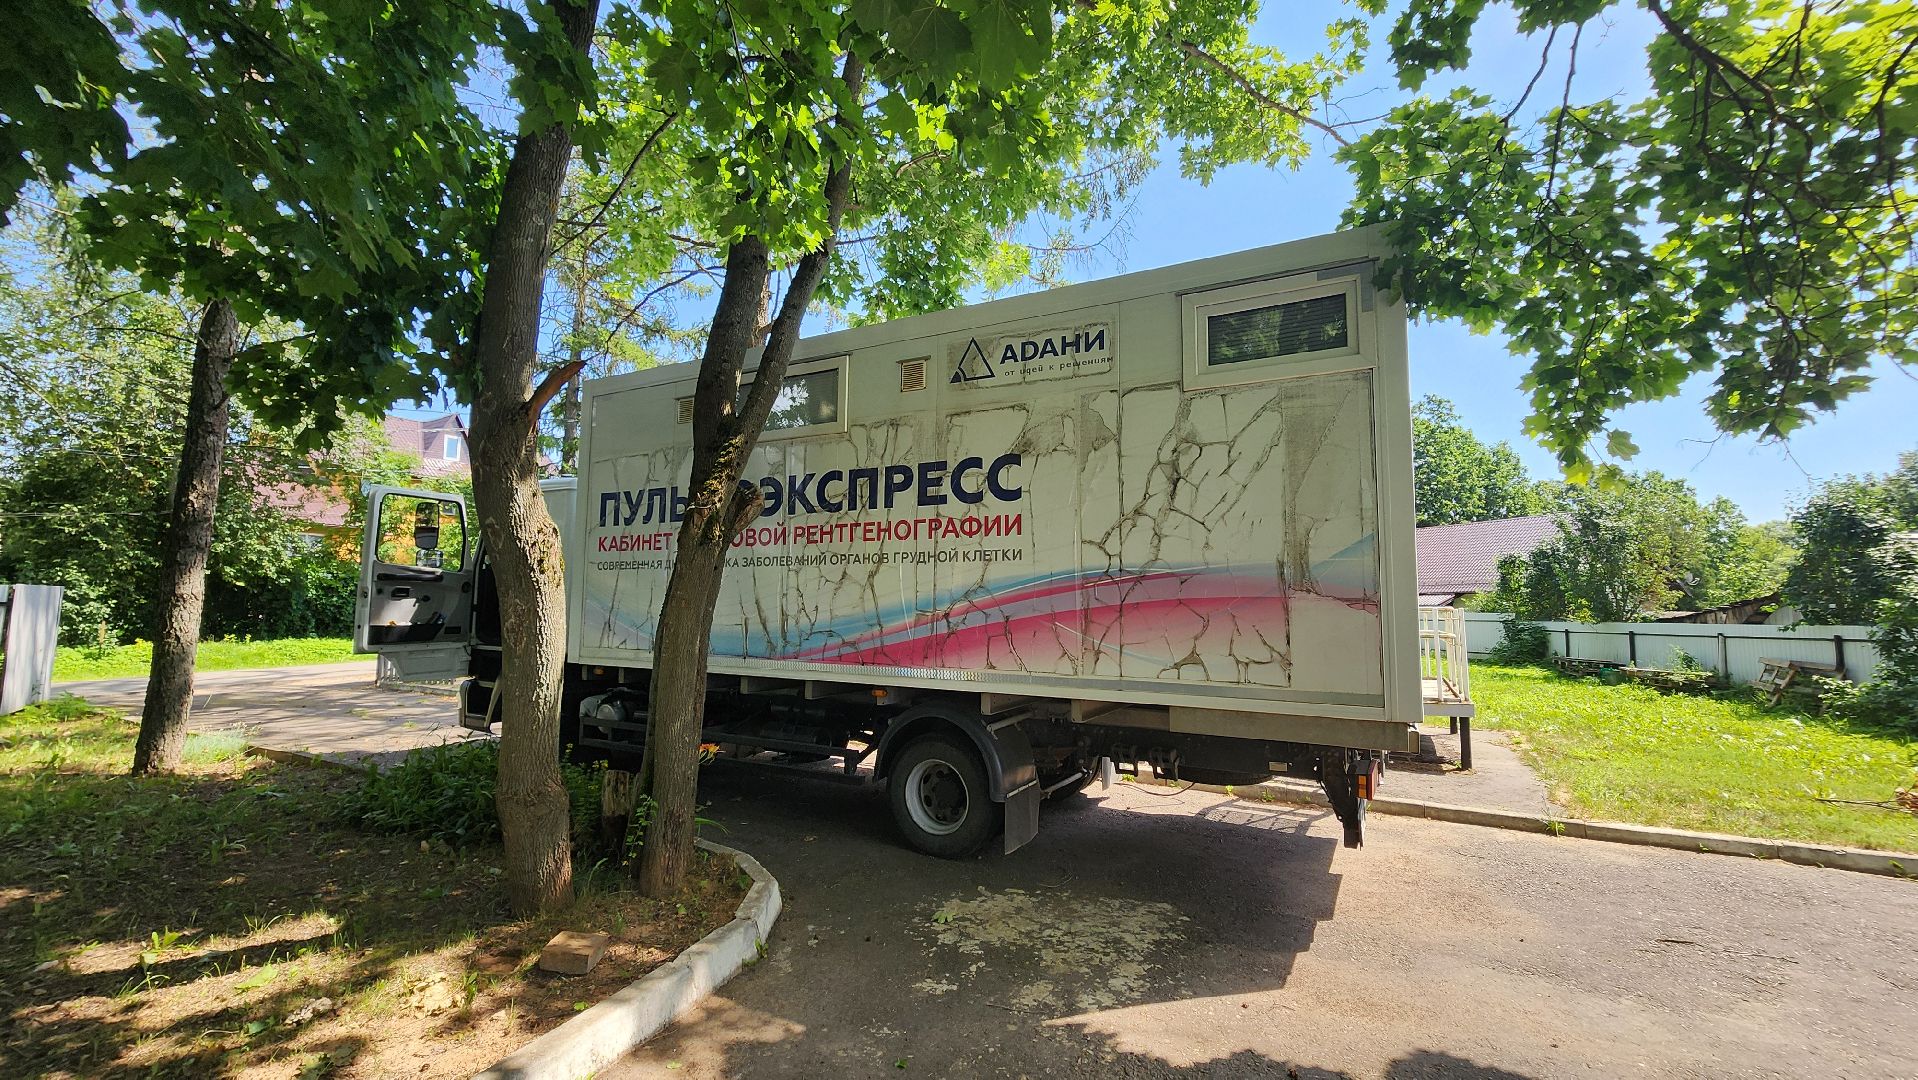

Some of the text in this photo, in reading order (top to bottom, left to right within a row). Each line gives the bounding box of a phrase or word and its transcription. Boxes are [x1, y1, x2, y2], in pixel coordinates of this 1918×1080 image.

[1060, 356, 1113, 371] решениям
[599, 454, 1022, 527] ПУЛЬЭКСПРЕСС
[598, 532, 673, 552] КАБИНЕТ
[794, 513, 1022, 545] РЕНТГЕНОГРАФИИ
[597, 560, 663, 571] СОВРЕМЕННАЯ
[742, 552, 827, 568] ЗАБОЛЕВАНИЙ
[829, 551, 889, 566] ОРГАНОВ
[893, 548, 959, 565] ГРУДНОЙ
[962, 549, 1023, 562] КЛЕТКИ
